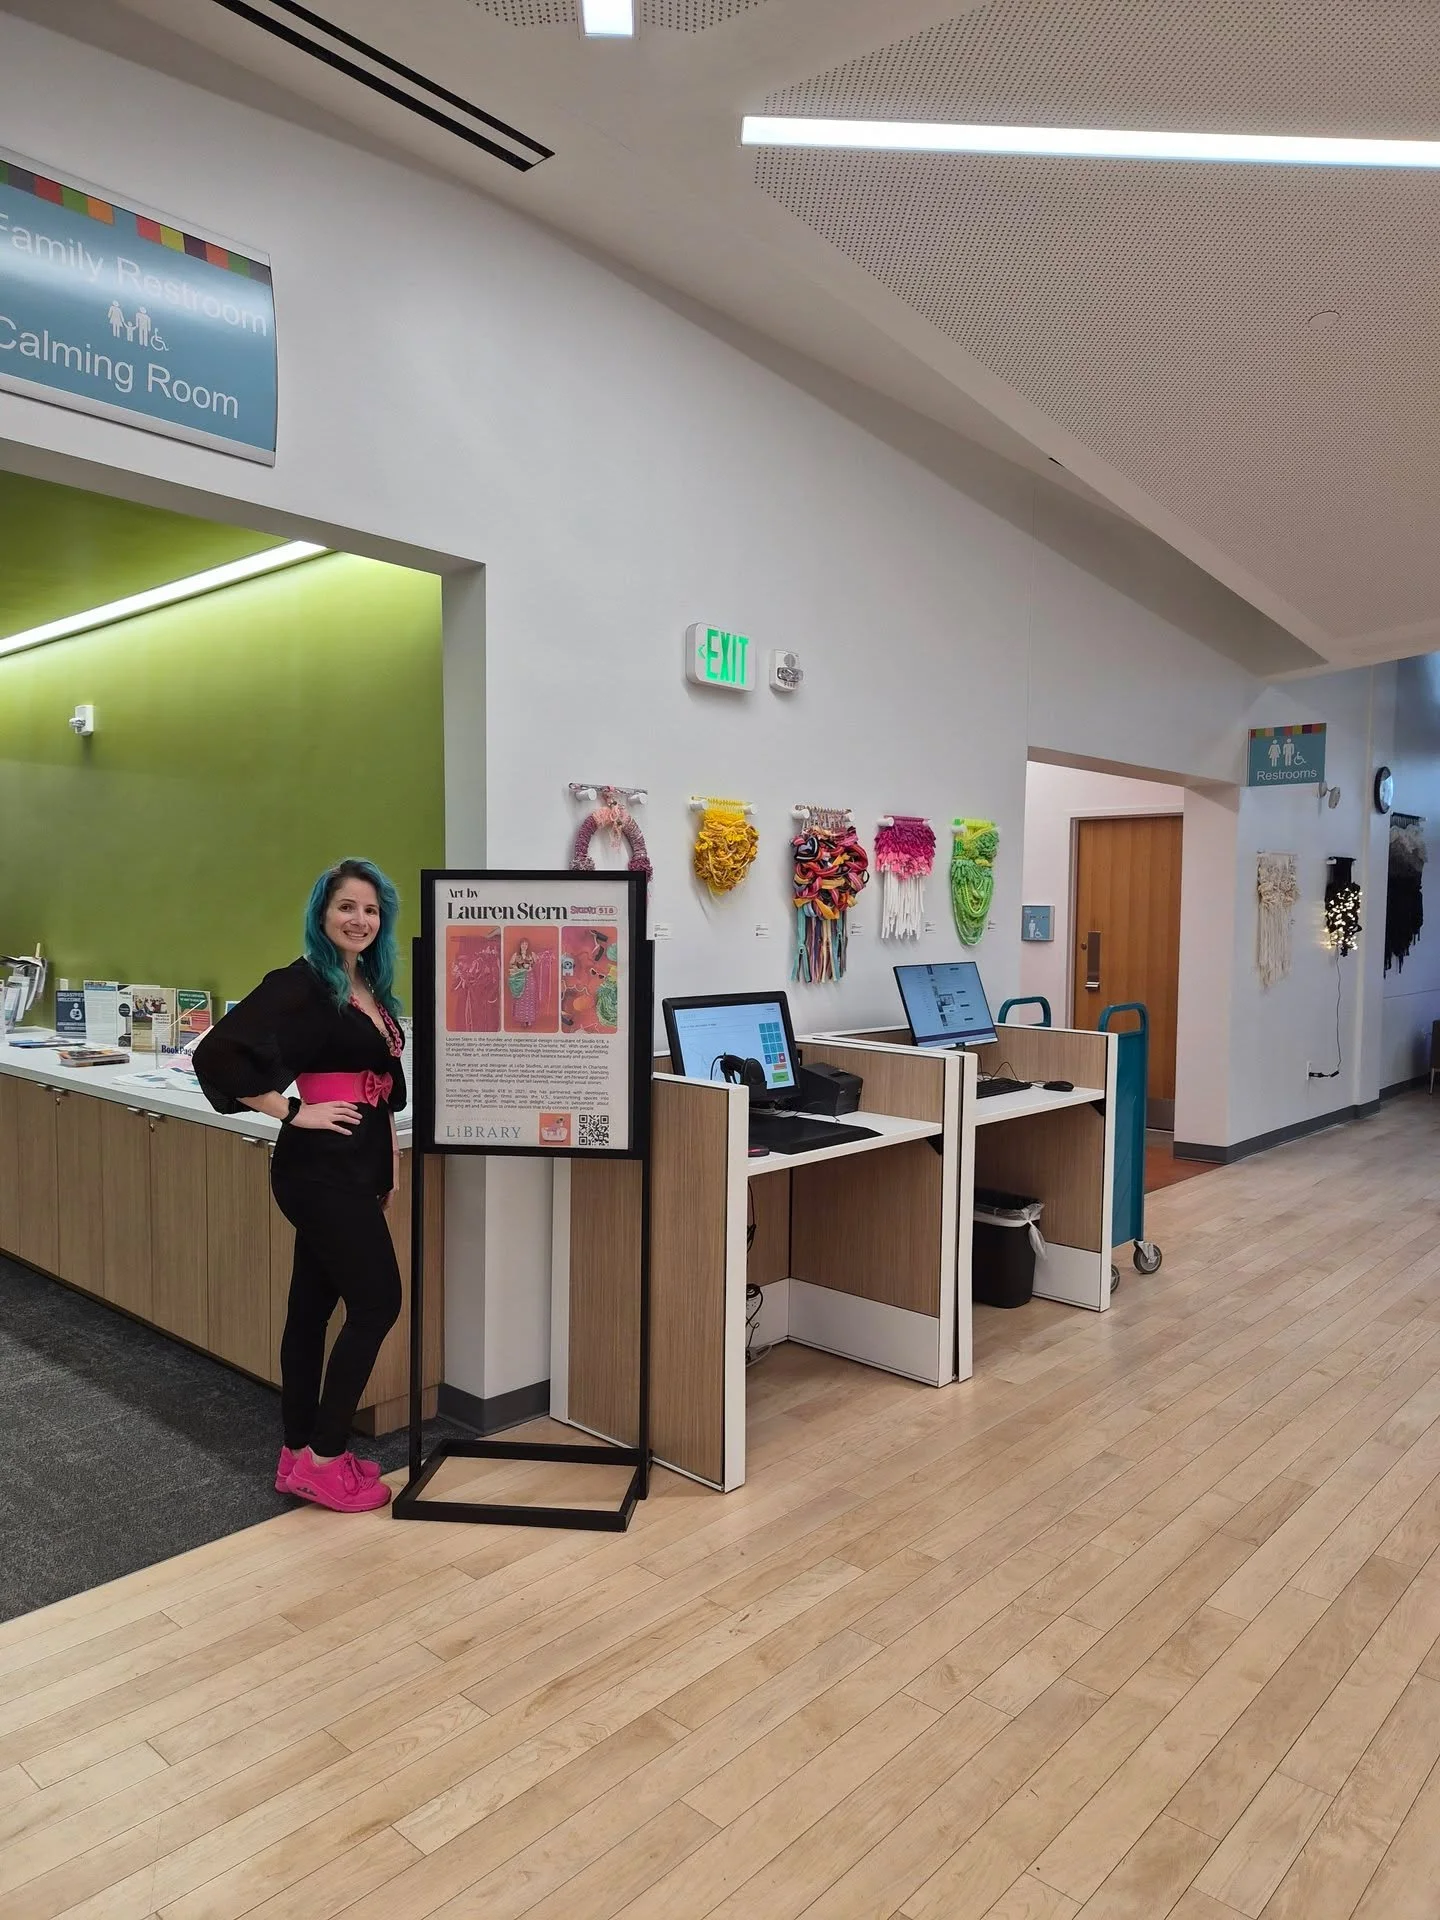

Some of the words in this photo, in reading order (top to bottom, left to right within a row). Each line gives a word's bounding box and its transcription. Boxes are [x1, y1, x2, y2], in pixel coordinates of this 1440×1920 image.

[116, 256, 267, 337] Restroom
[0, 315, 134, 394] Calming
[148, 363, 239, 419] Room
[706, 628, 750, 686] EXIT
[1256, 768, 1317, 781] Restrooms
[448, 888, 464, 898] Art
[467, 888, 480, 899] by
[448, 902, 514, 920] Lauren
[517, 902, 568, 920] Stern
